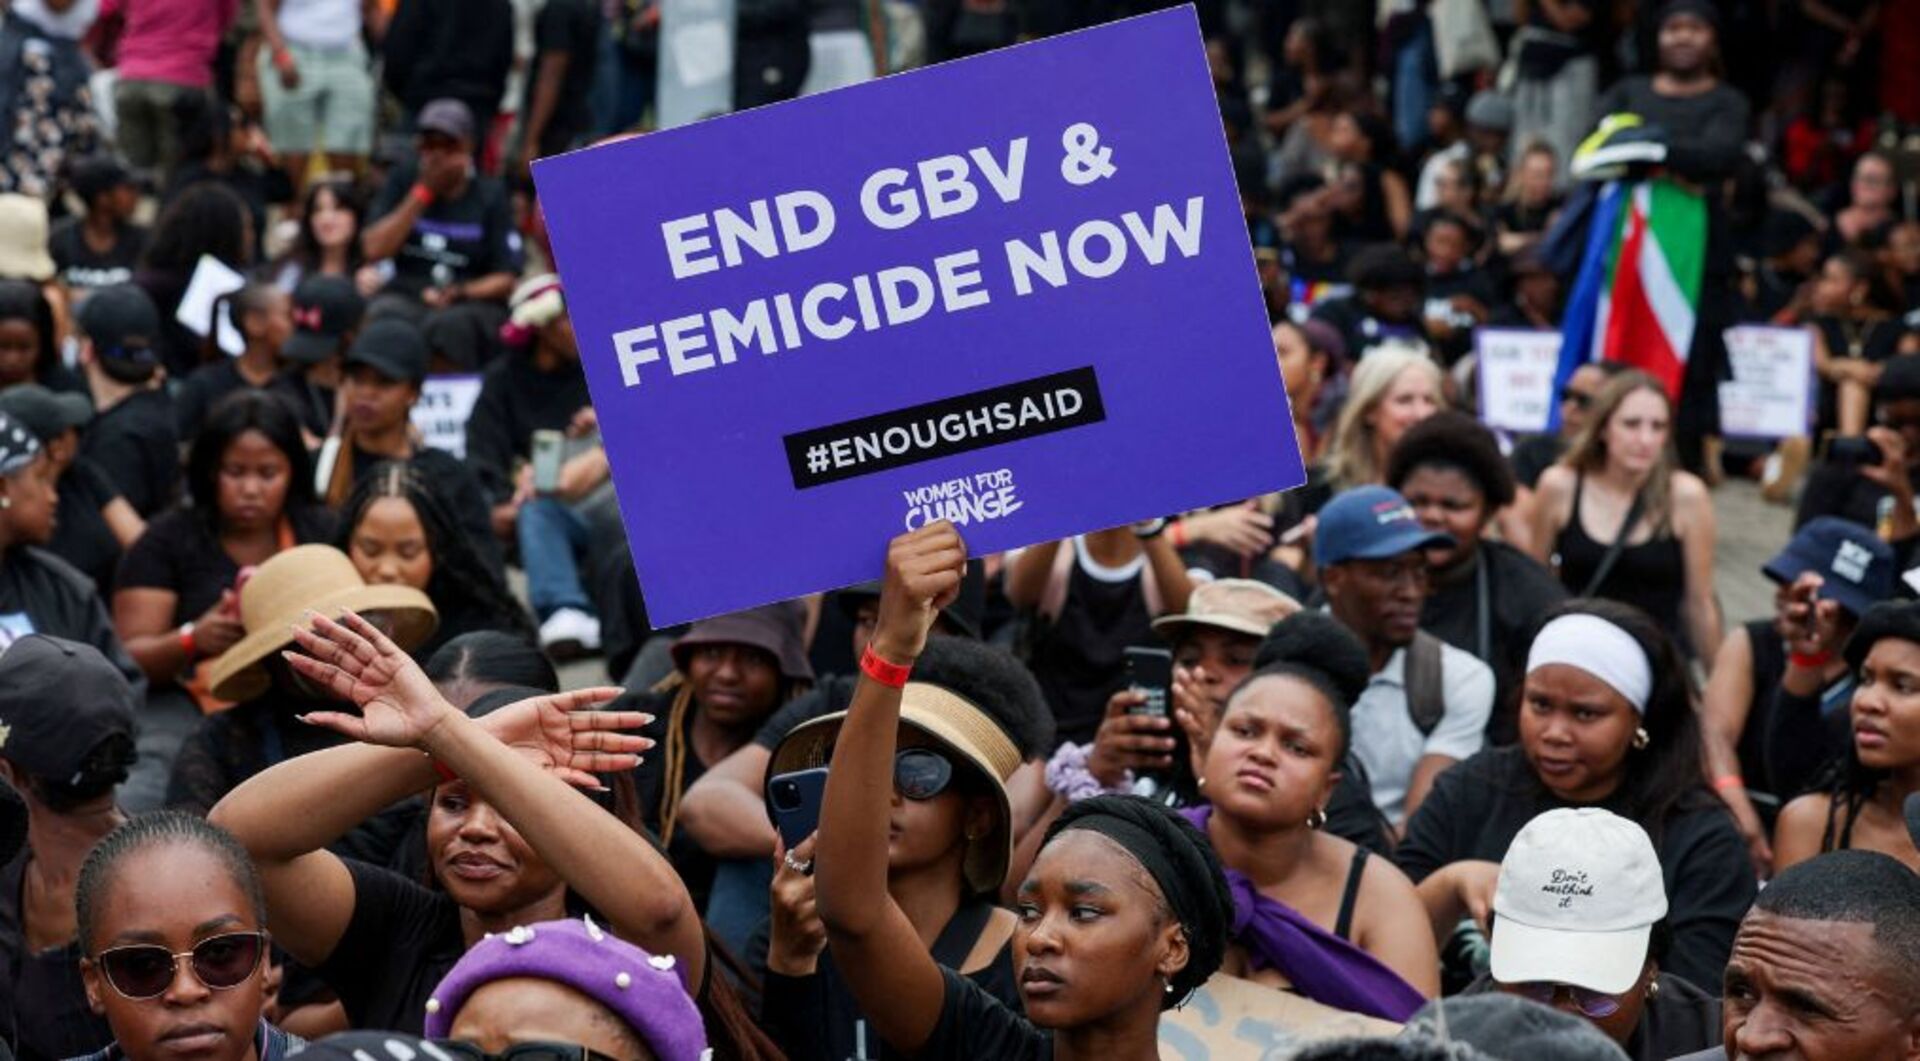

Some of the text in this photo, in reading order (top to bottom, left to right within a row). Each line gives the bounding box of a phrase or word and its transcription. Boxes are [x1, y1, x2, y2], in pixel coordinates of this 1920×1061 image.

[662, 123, 1117, 279] END GBV &
[613, 197, 1203, 386] FEMICIDE NOW
[807, 388, 1082, 473] #ENOUGHSAID
[903, 468, 1013, 507] WOMEN FOR
[905, 485, 1024, 533] CHANGE
[1551, 869, 1588, 884] Don't
[1558, 896, 1572, 908] it
